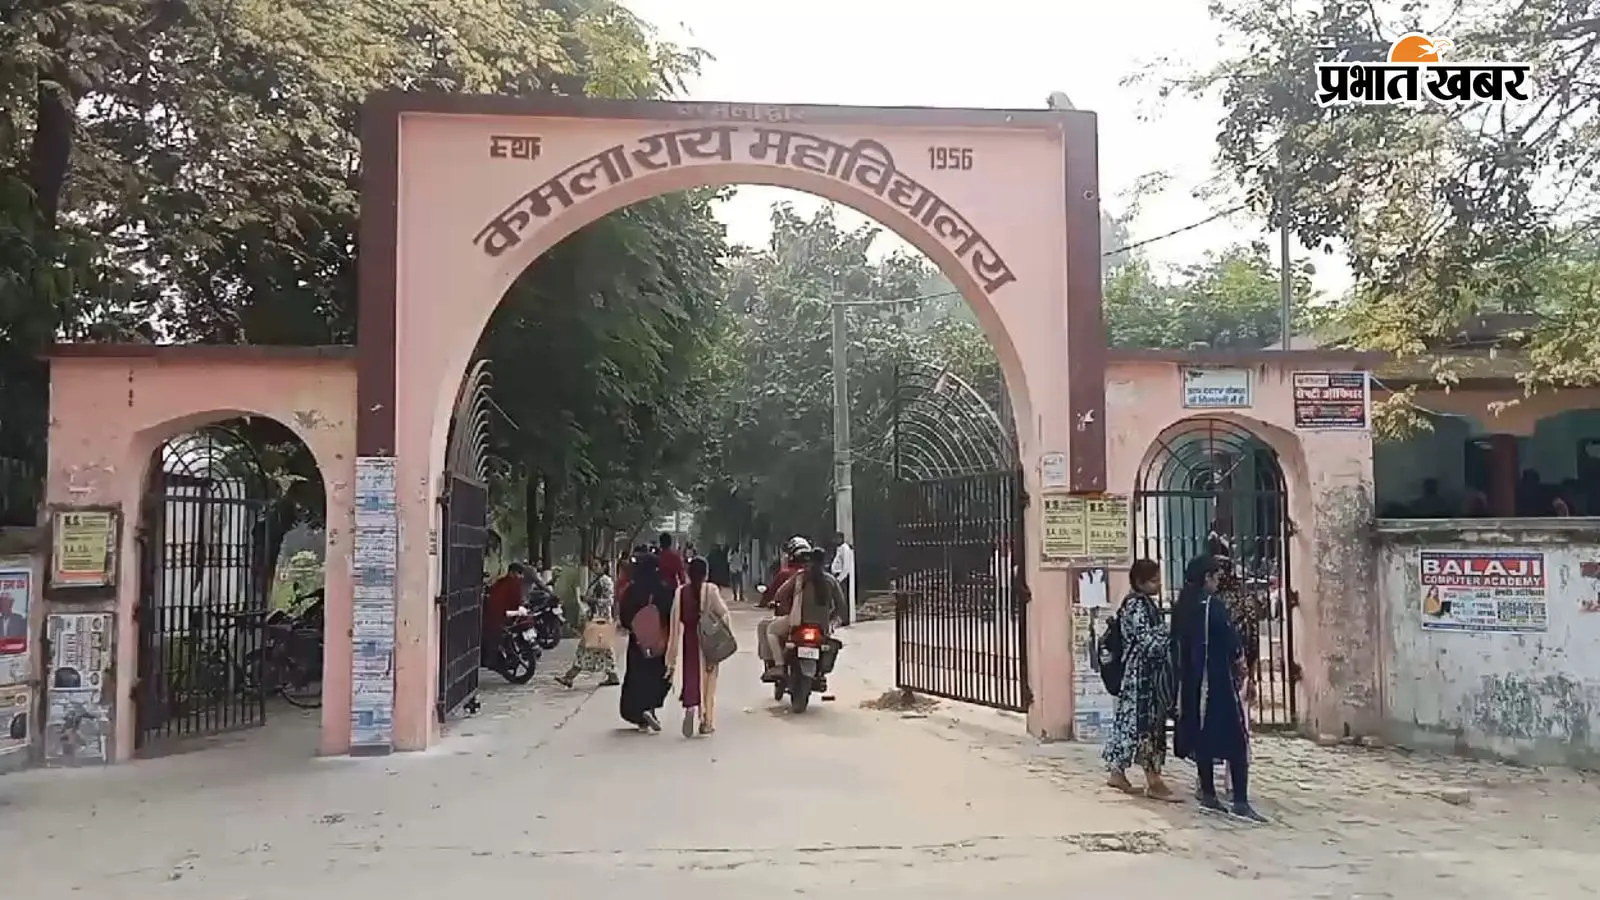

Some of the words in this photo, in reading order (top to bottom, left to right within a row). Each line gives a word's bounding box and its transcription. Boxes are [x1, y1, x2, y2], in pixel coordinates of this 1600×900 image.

[927, 146, 973, 171] 1956
[749, 128, 1017, 293] महाविद्यालय
[1422, 559, 1541, 576] BALAJI
[1424, 574, 1481, 586] COMPUTER
[1484, 577, 1541, 587] ACADEMY
